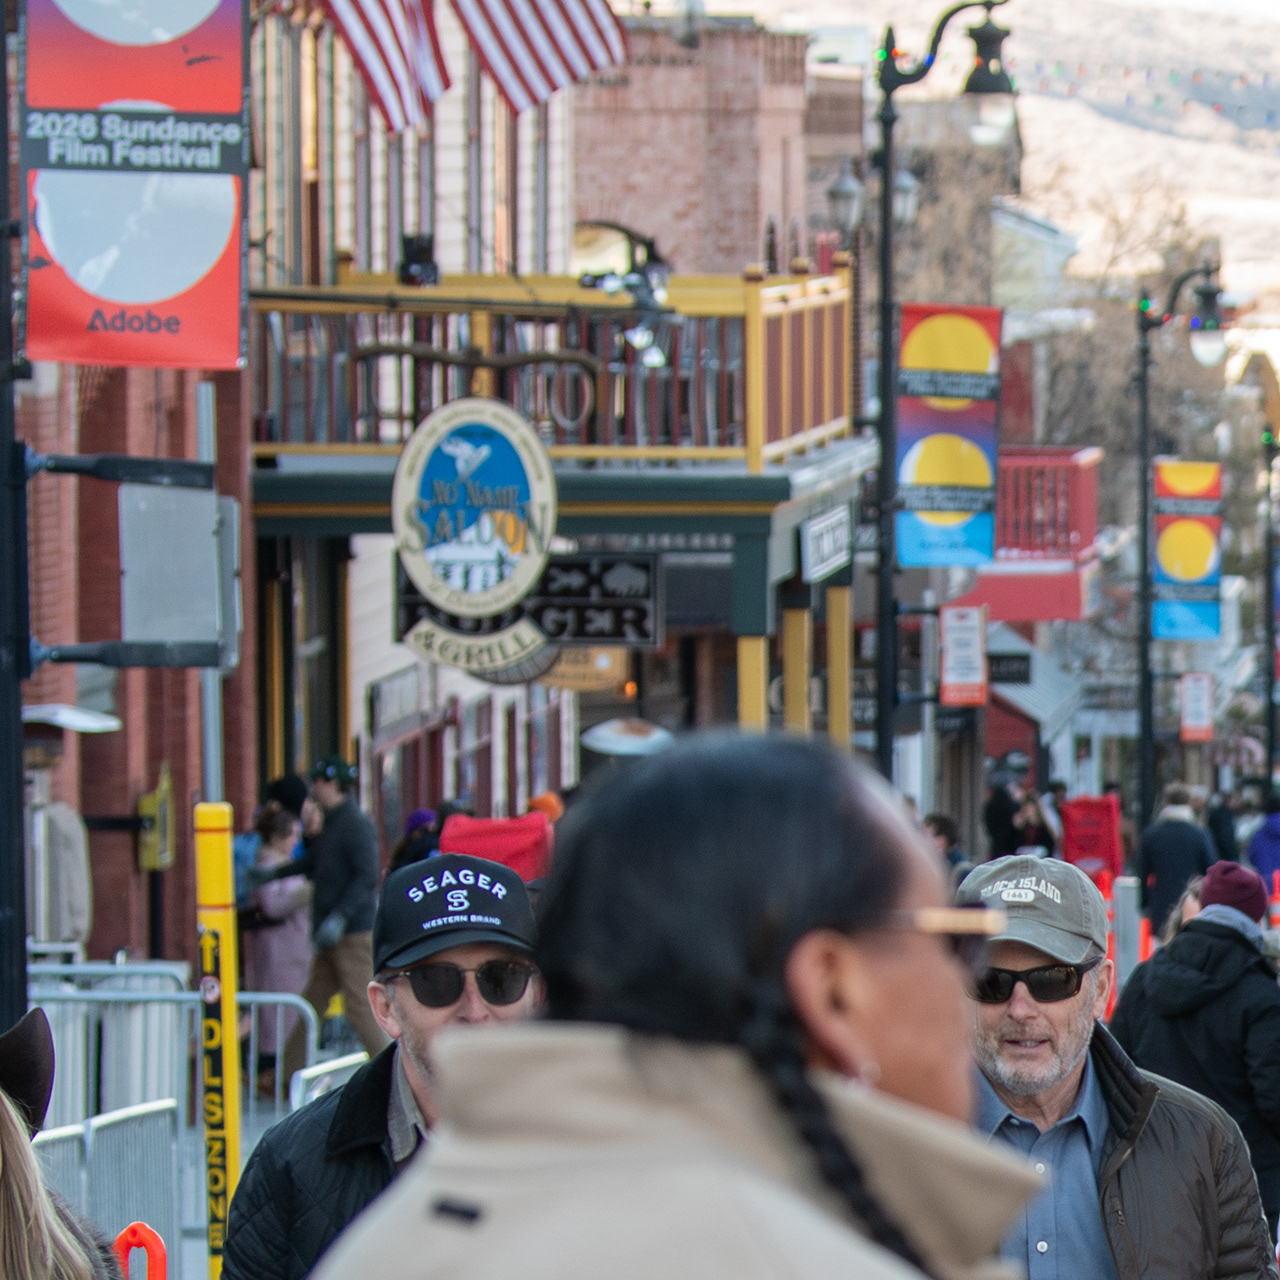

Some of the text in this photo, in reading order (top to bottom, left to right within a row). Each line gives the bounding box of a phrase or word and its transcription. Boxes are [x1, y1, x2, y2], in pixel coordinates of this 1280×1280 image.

[26, 112, 243, 145] 2026 Sundance
[48, 138, 222, 168] Film Festival
[86, 308, 182, 334] Adobe
[407, 869, 508, 903] SEAGER
[1018, 876, 1062, 904] ISLAND
[422, 914, 502, 930] WESTERN BRAND
